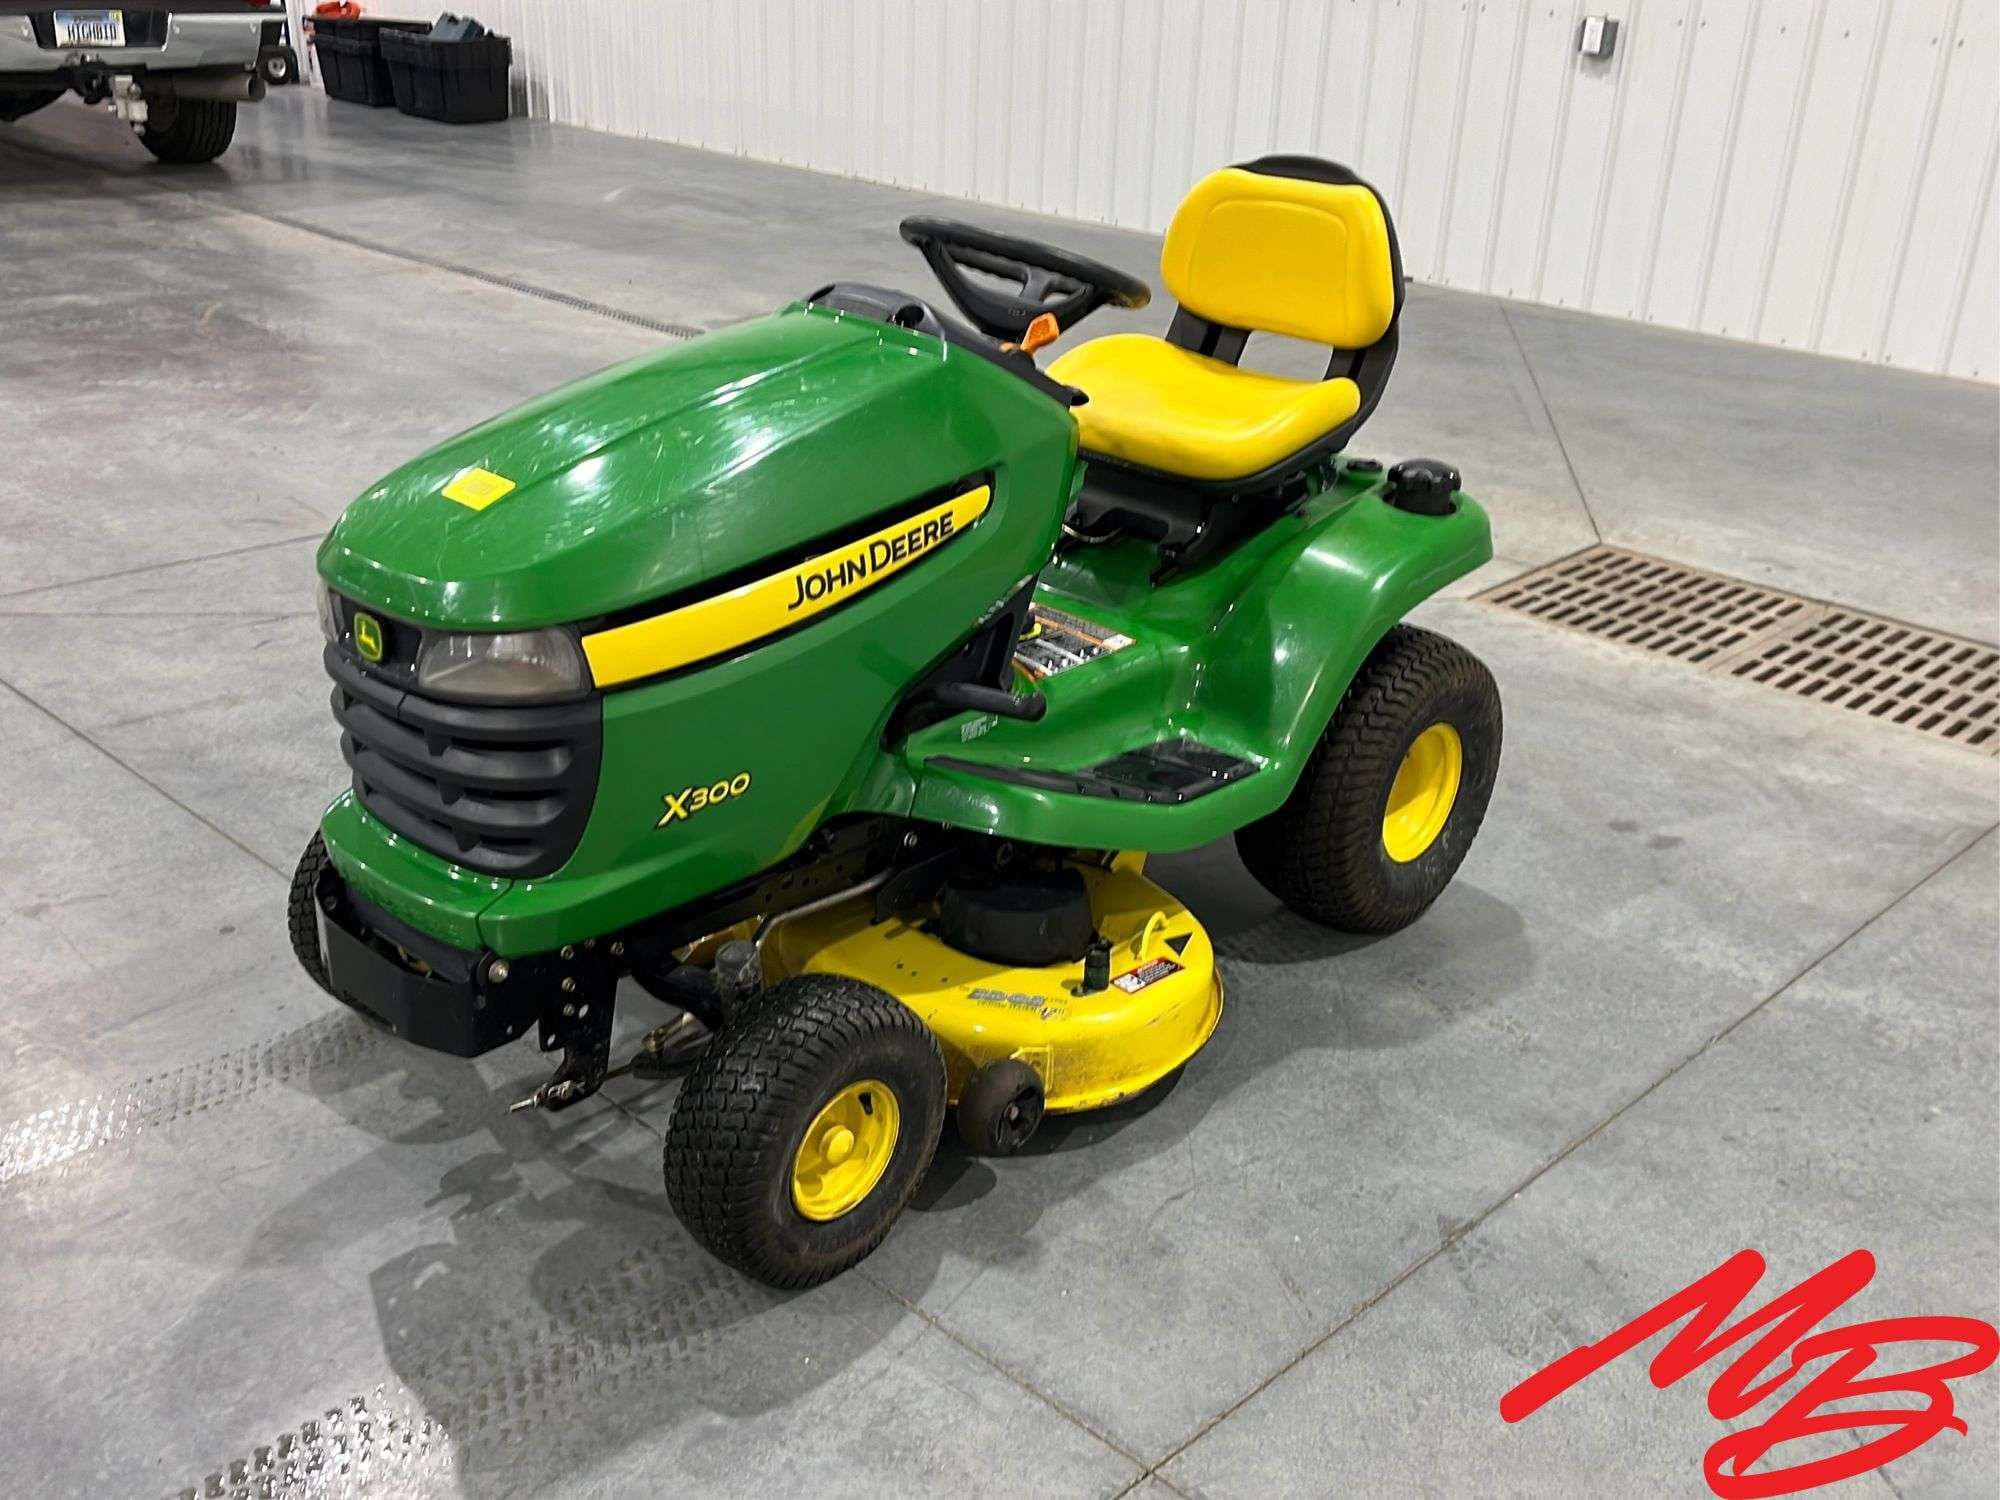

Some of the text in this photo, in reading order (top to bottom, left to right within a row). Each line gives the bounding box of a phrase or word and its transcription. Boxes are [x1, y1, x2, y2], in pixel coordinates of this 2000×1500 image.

[787, 510, 954, 612] JOHN DEERE
[656, 771, 751, 829] X300
